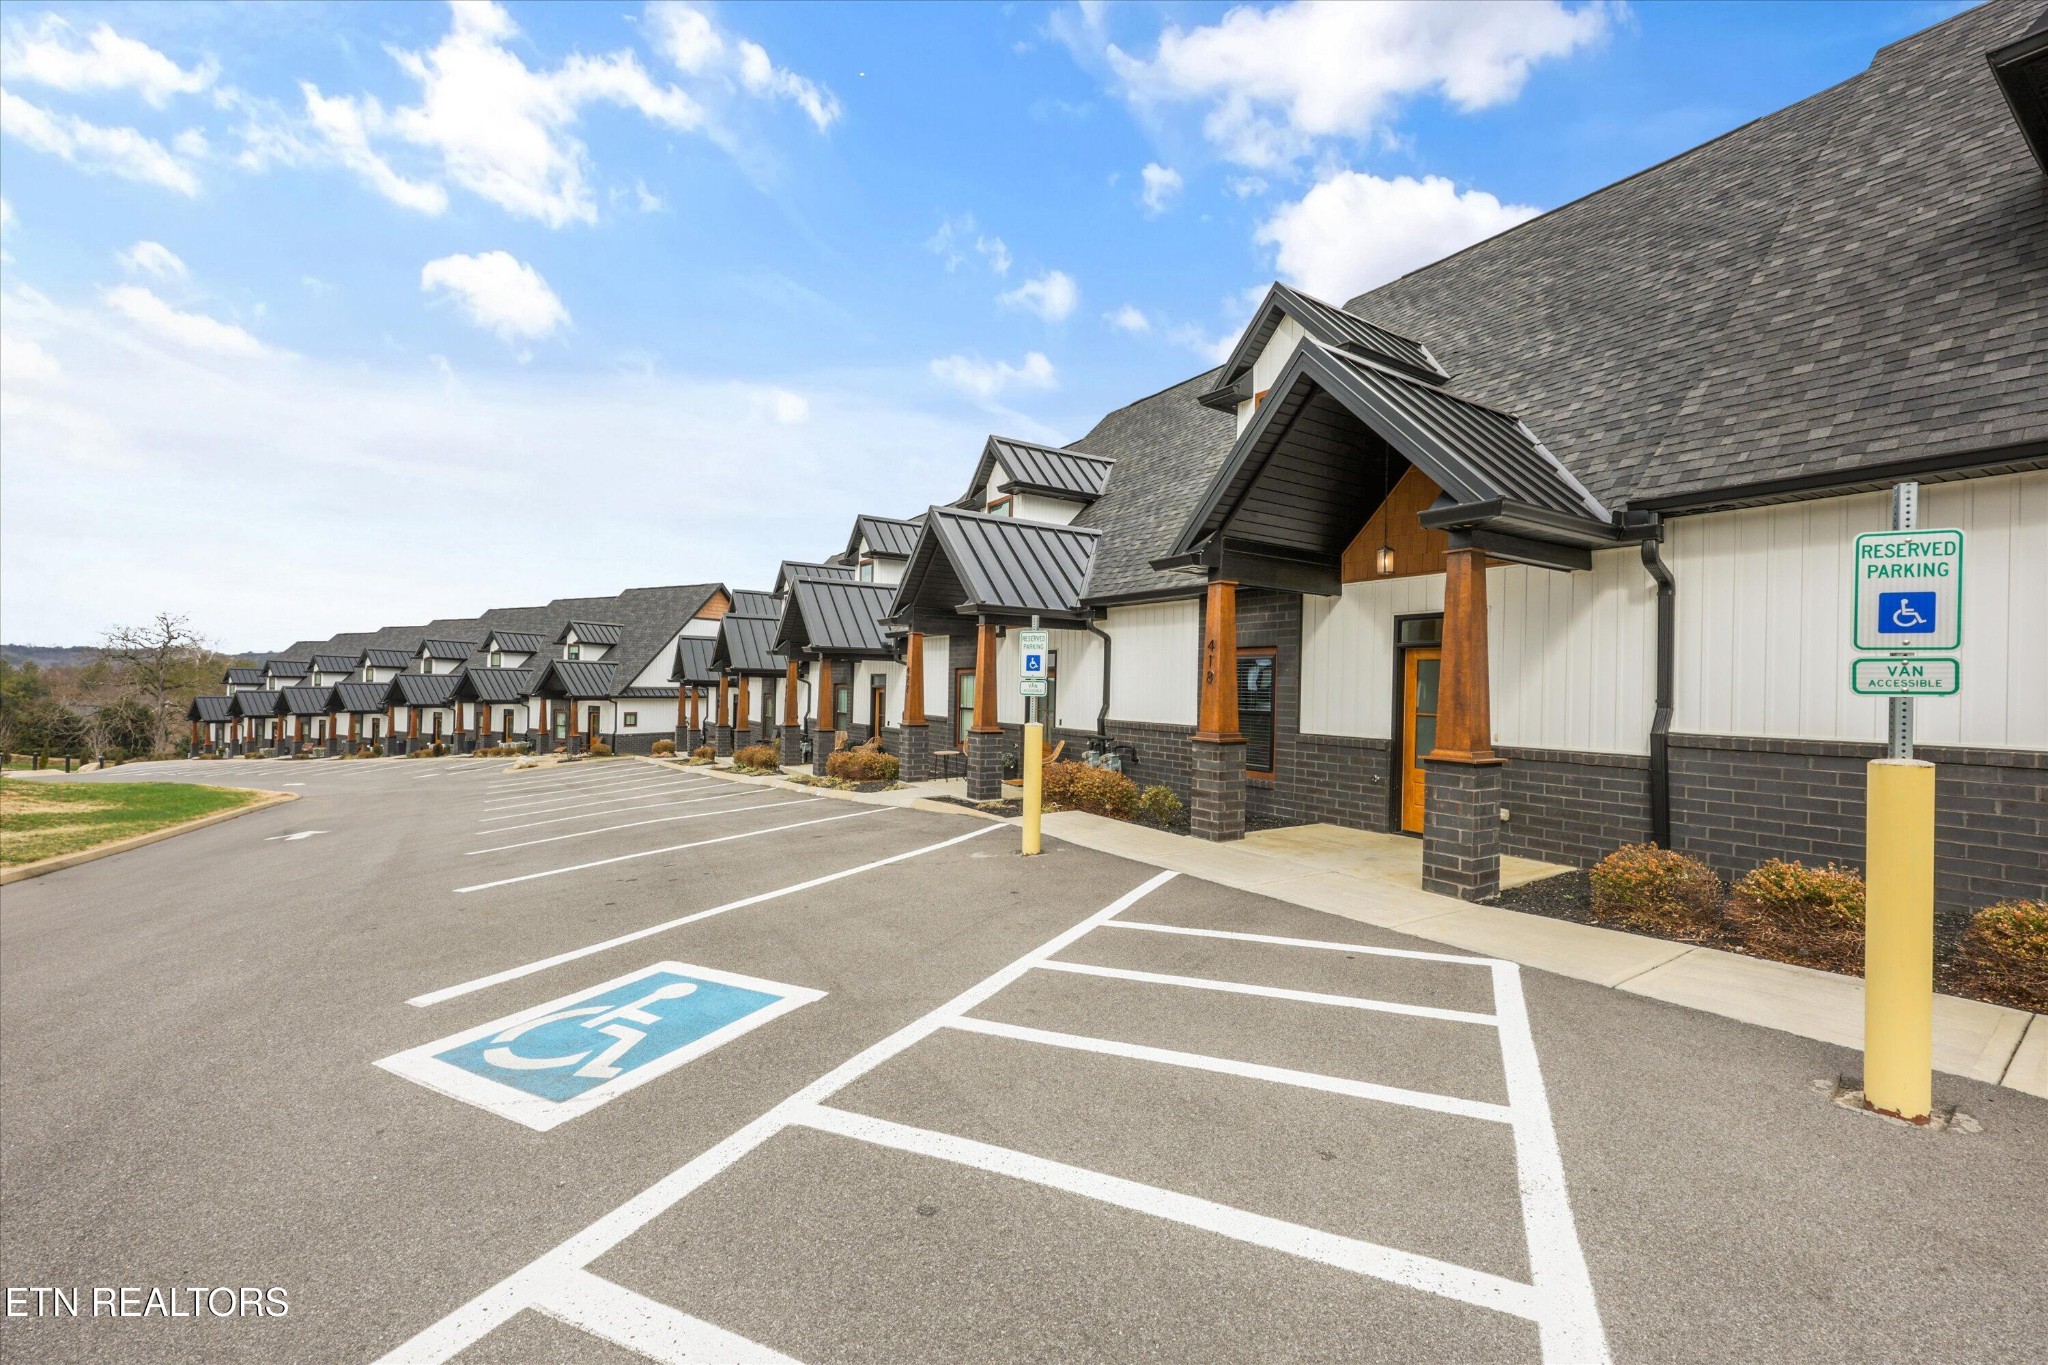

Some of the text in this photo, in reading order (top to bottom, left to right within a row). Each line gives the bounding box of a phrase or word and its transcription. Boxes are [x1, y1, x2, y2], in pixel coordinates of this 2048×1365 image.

[1861, 541, 1956, 559] RESERVED
[1867, 562, 1949, 579] PARKING
[1207, 640, 1215, 685] 418
[1887, 666, 1924, 677] VAN
[1868, 679, 1943, 688] ACCESSIBLE
